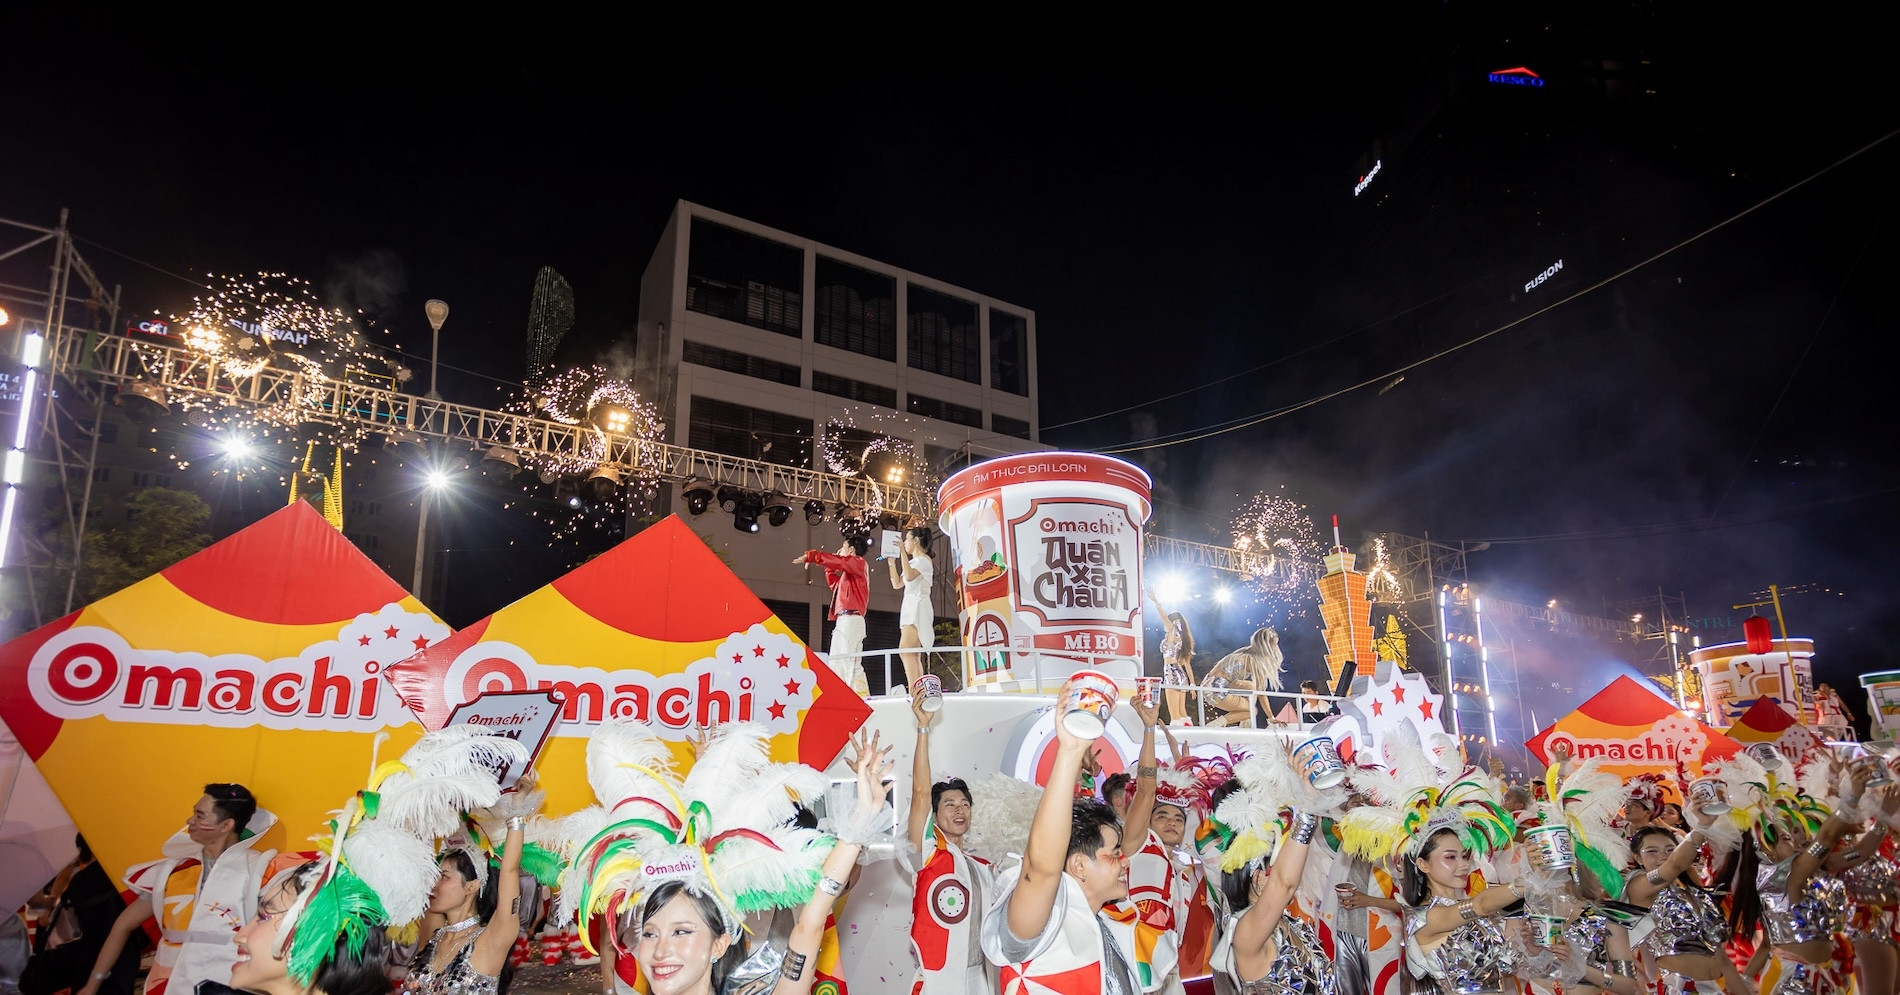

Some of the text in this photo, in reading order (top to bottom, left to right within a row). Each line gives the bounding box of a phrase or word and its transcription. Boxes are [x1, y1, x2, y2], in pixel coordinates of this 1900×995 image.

[1488, 73, 1544, 87] RESCO
[1354, 159, 1382, 196] Keppel
[1524, 259, 1564, 293] FUSION
[991, 465, 1026, 478] THỰC
[1028, 462, 1050, 473] ĐÀI
[1052, 463, 1087, 473] LOAN
[1039, 517, 1114, 535] Omachi
[1033, 569, 1128, 611] Châu Á
[48, 642, 380, 719] Omachi
[463, 657, 755, 727] Omachi
[467, 713, 525, 726] Omachi
[1551, 736, 1675, 760] Omachi
[645, 860, 692, 876] Omachi
